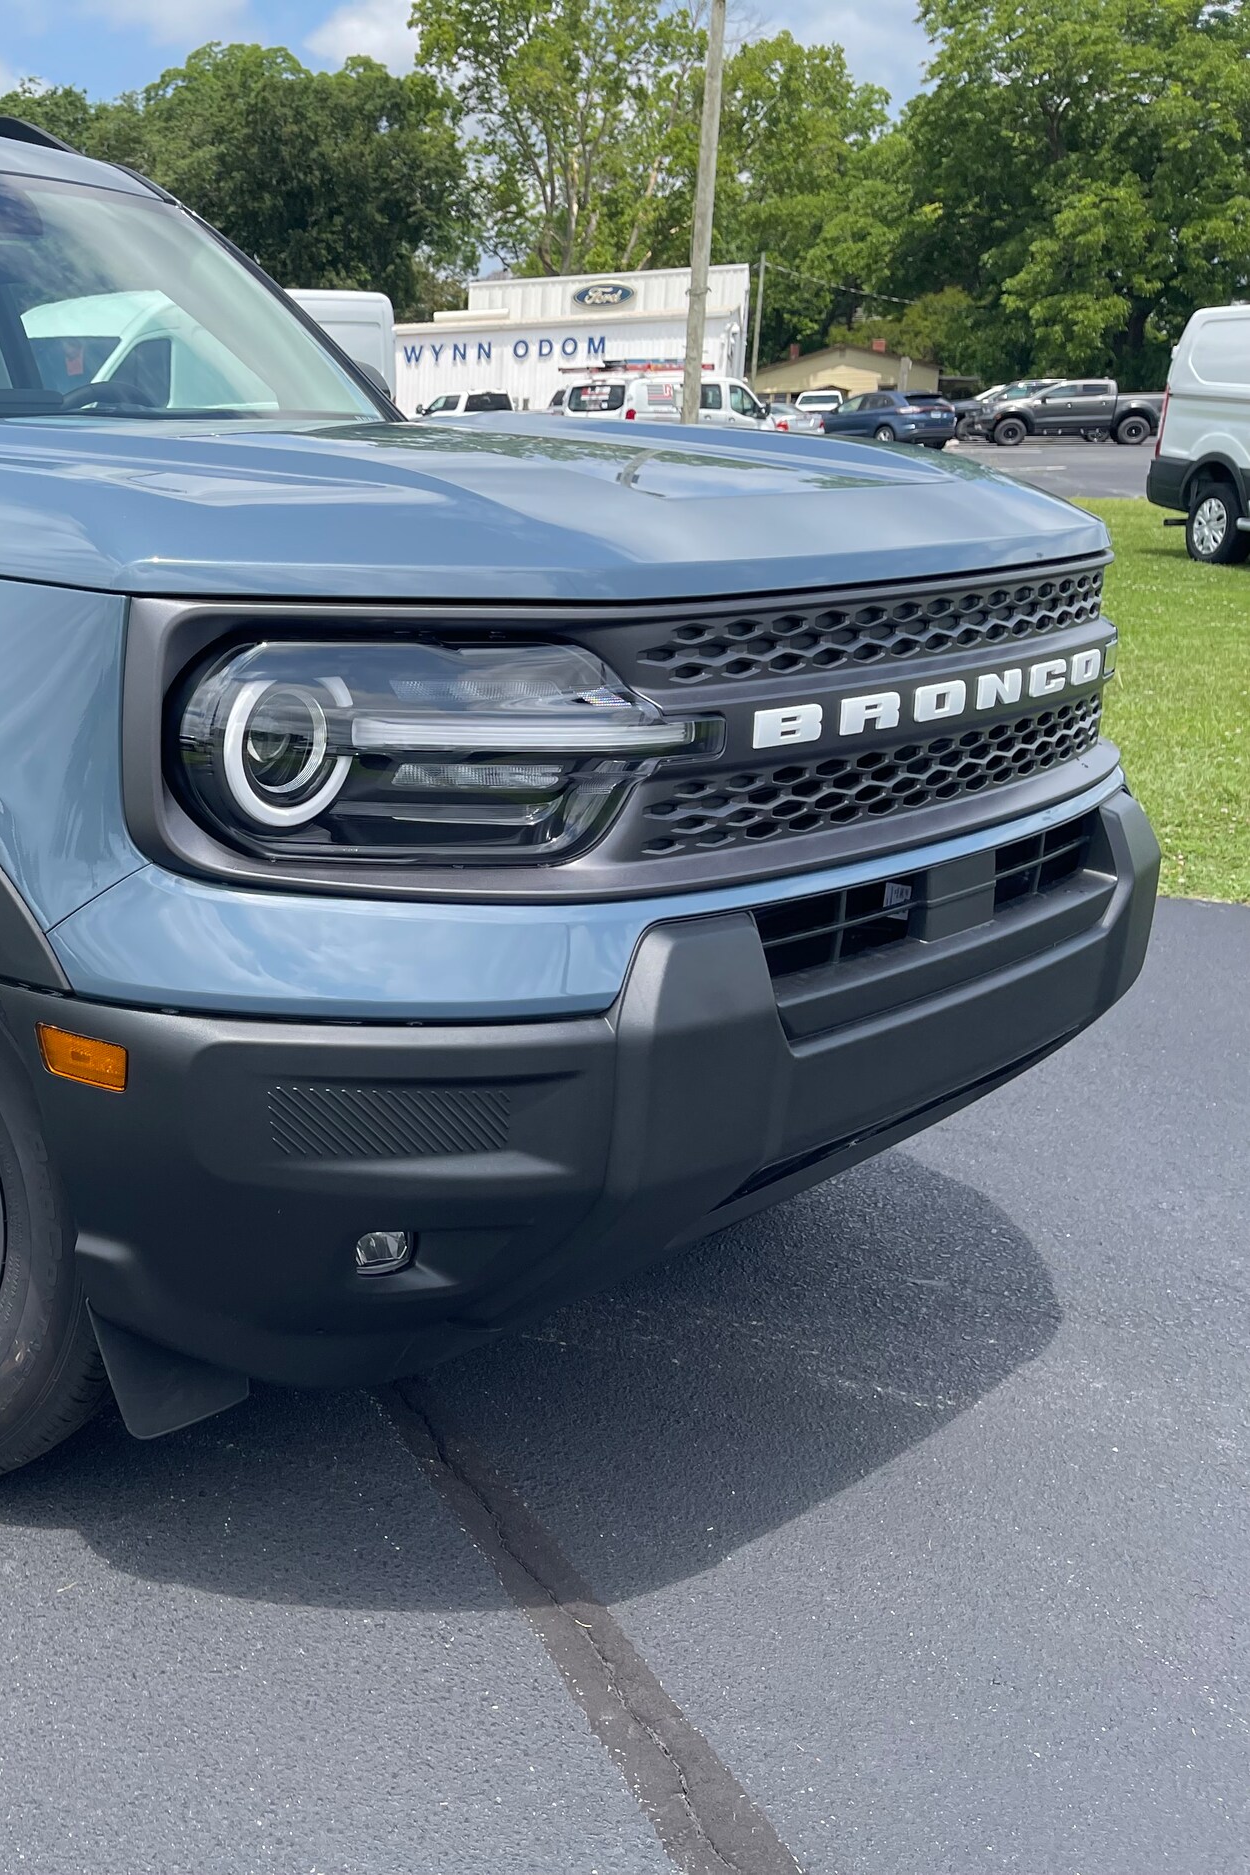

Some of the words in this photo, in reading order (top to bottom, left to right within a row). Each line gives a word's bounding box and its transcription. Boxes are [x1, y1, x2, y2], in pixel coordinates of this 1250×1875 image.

[584, 287, 623, 304] Ford
[403, 341, 492, 363] WYNN
[513, 336, 605, 358] ODOM
[752, 648, 1102, 750] BRONCO
